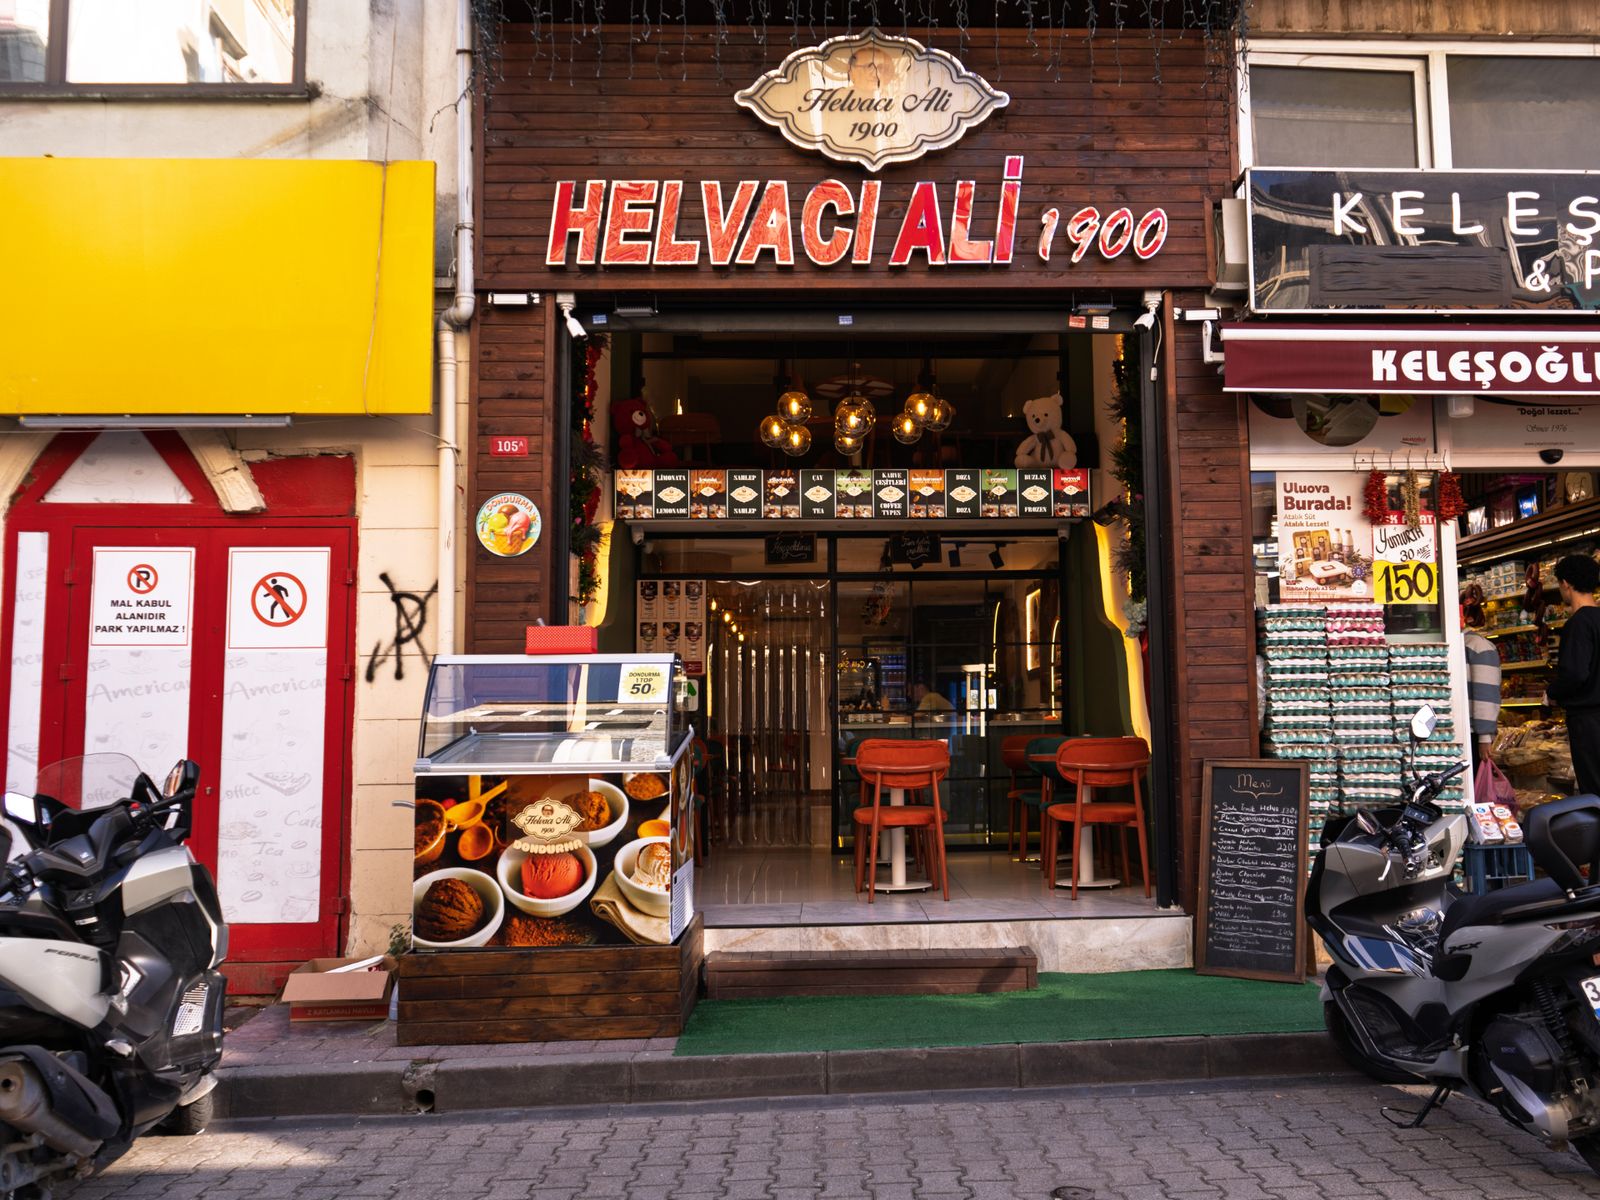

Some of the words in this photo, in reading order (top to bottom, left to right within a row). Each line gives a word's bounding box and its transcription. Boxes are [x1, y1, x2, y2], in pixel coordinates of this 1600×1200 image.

[797, 86, 894, 113] Helvacı
[902, 86, 953, 113] Ali
[849, 121, 898, 141] 1900
[545, 178, 882, 266] HELVACI
[888, 155, 1024, 265] ALİ
[1038, 205, 1168, 265] 1900
[1524, 259, 1551, 293] &
[1371, 345, 1600, 389] KELEŞOĞL
[812, 474, 824, 482] ÇAY
[1283, 482, 1330, 494] Uluova
[486, 495, 534, 512] DONDURMA
[1283, 495, 1352, 511] Burada!
[1400, 548, 1415, 562] 30
[1378, 562, 1434, 603] 150
[110, 599, 132, 607] MAL
[135, 599, 171, 607] KABUL
[115, 612, 166, 620] ALANIDIR
[94, 625, 123, 633] PARK
[126, 625, 178, 633] YAPILMAZ
[1237, 773, 1271, 788] Menü
[85, 787, 121, 803] offee
[222, 785, 261, 801] offee
[524, 815, 554, 825] Helvacı
[555, 815, 572, 825] Ali
[512, 839, 583, 855] DONDURMA
[1585, 982, 1600, 1002] 3
